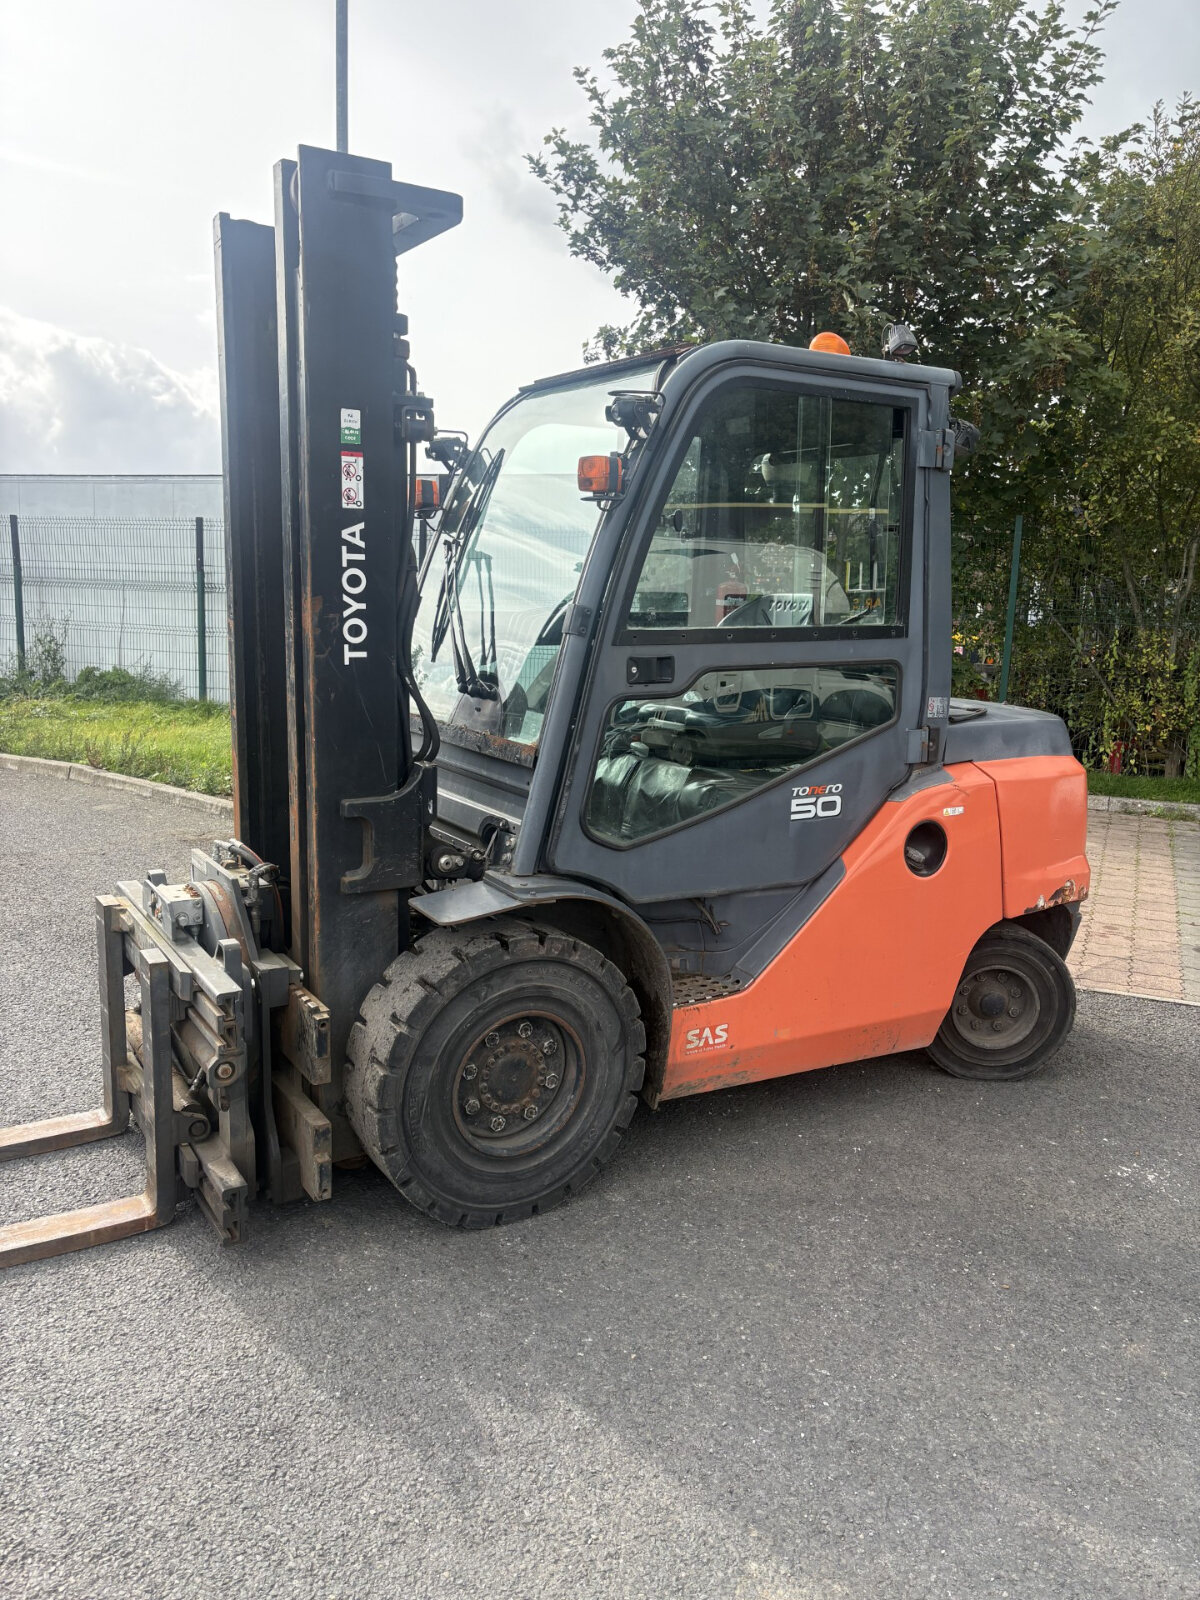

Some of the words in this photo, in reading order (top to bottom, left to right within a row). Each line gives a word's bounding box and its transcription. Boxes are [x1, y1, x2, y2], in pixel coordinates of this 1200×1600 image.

[341, 521, 368, 666] TOYOTA
[790, 795, 842, 820] 50
[685, 1023, 729, 1049] SAS
